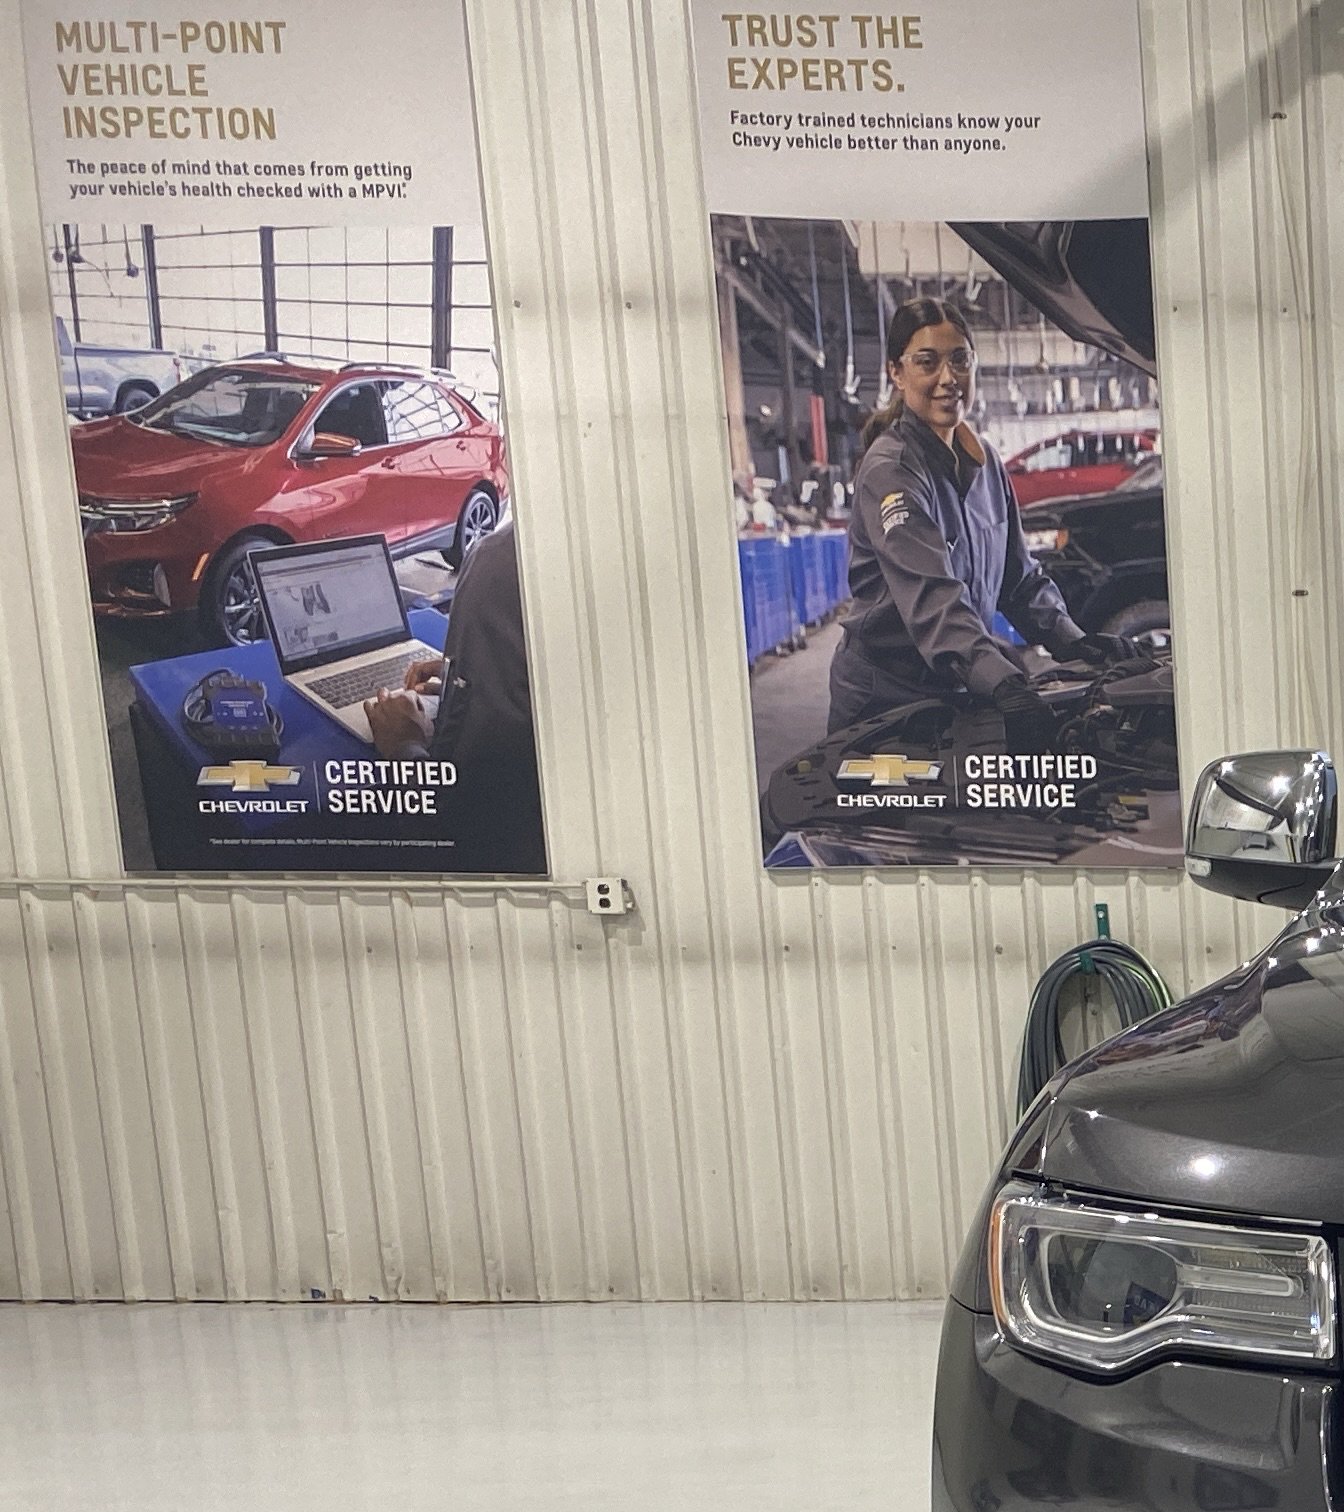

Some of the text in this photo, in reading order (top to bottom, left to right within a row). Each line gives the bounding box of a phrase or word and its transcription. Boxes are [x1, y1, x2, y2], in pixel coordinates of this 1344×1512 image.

[56, 21, 286, 54] MULTI-POINT
[722, 15, 923, 50] TRUST THE
[57, 64, 208, 97] VEHICLE
[727, 57, 905, 93] EXPERTS.
[63, 107, 277, 140] INSPECTION
[730, 110, 1041, 132] Factory trained technicians know your
[732, 131, 1006, 154] Chevy vehicle better than anyone.
[67, 160, 412, 181] The peace of mind that comes from getting
[69, 185, 104, 199] your
[109, 182, 177, 197] vehicle's
[182, 182, 232, 197] health
[237, 182, 302, 198] checked
[308, 183, 344, 198] with
[348, 187, 357, 198] a
[325, 760, 457, 785] CERTIFIED
[964, 755, 1097, 779] CERTIFIED
[199, 801, 309, 814] CHEVROLET
[328, 791, 437, 814] SERVICE
[837, 794, 947, 808] CHEVROLET
[966, 784, 1076, 808] SERVICE
